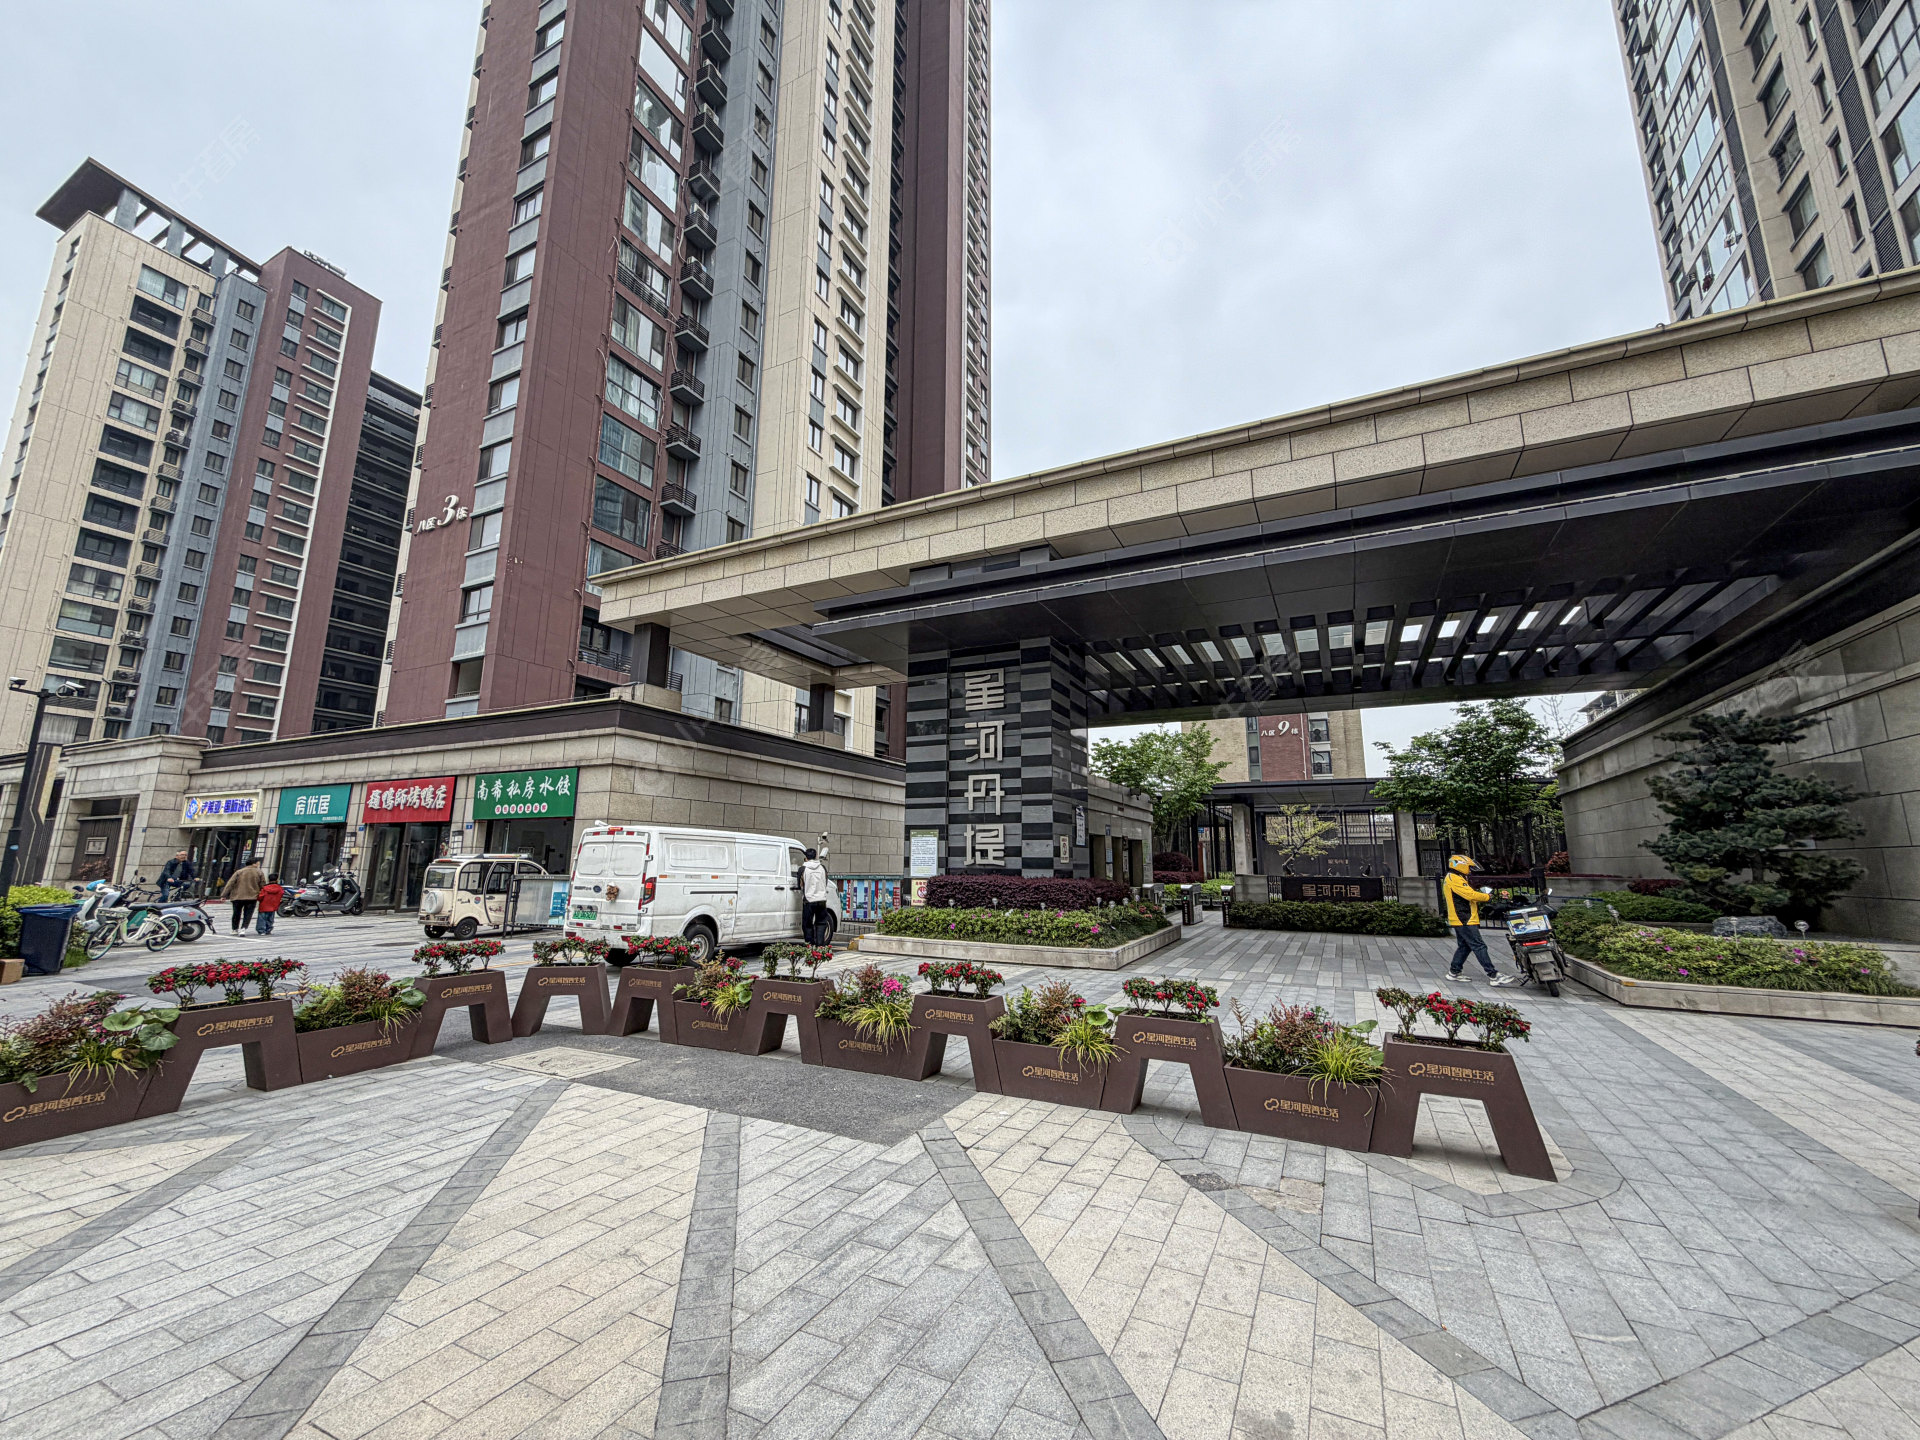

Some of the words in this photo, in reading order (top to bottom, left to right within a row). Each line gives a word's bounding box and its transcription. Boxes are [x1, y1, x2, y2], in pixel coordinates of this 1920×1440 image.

[964, 667, 1005, 867] 星河丹堤
[477, 774, 571, 802] 南希私房水饺
[1302, 884, 1361, 898] 星河丹堤
